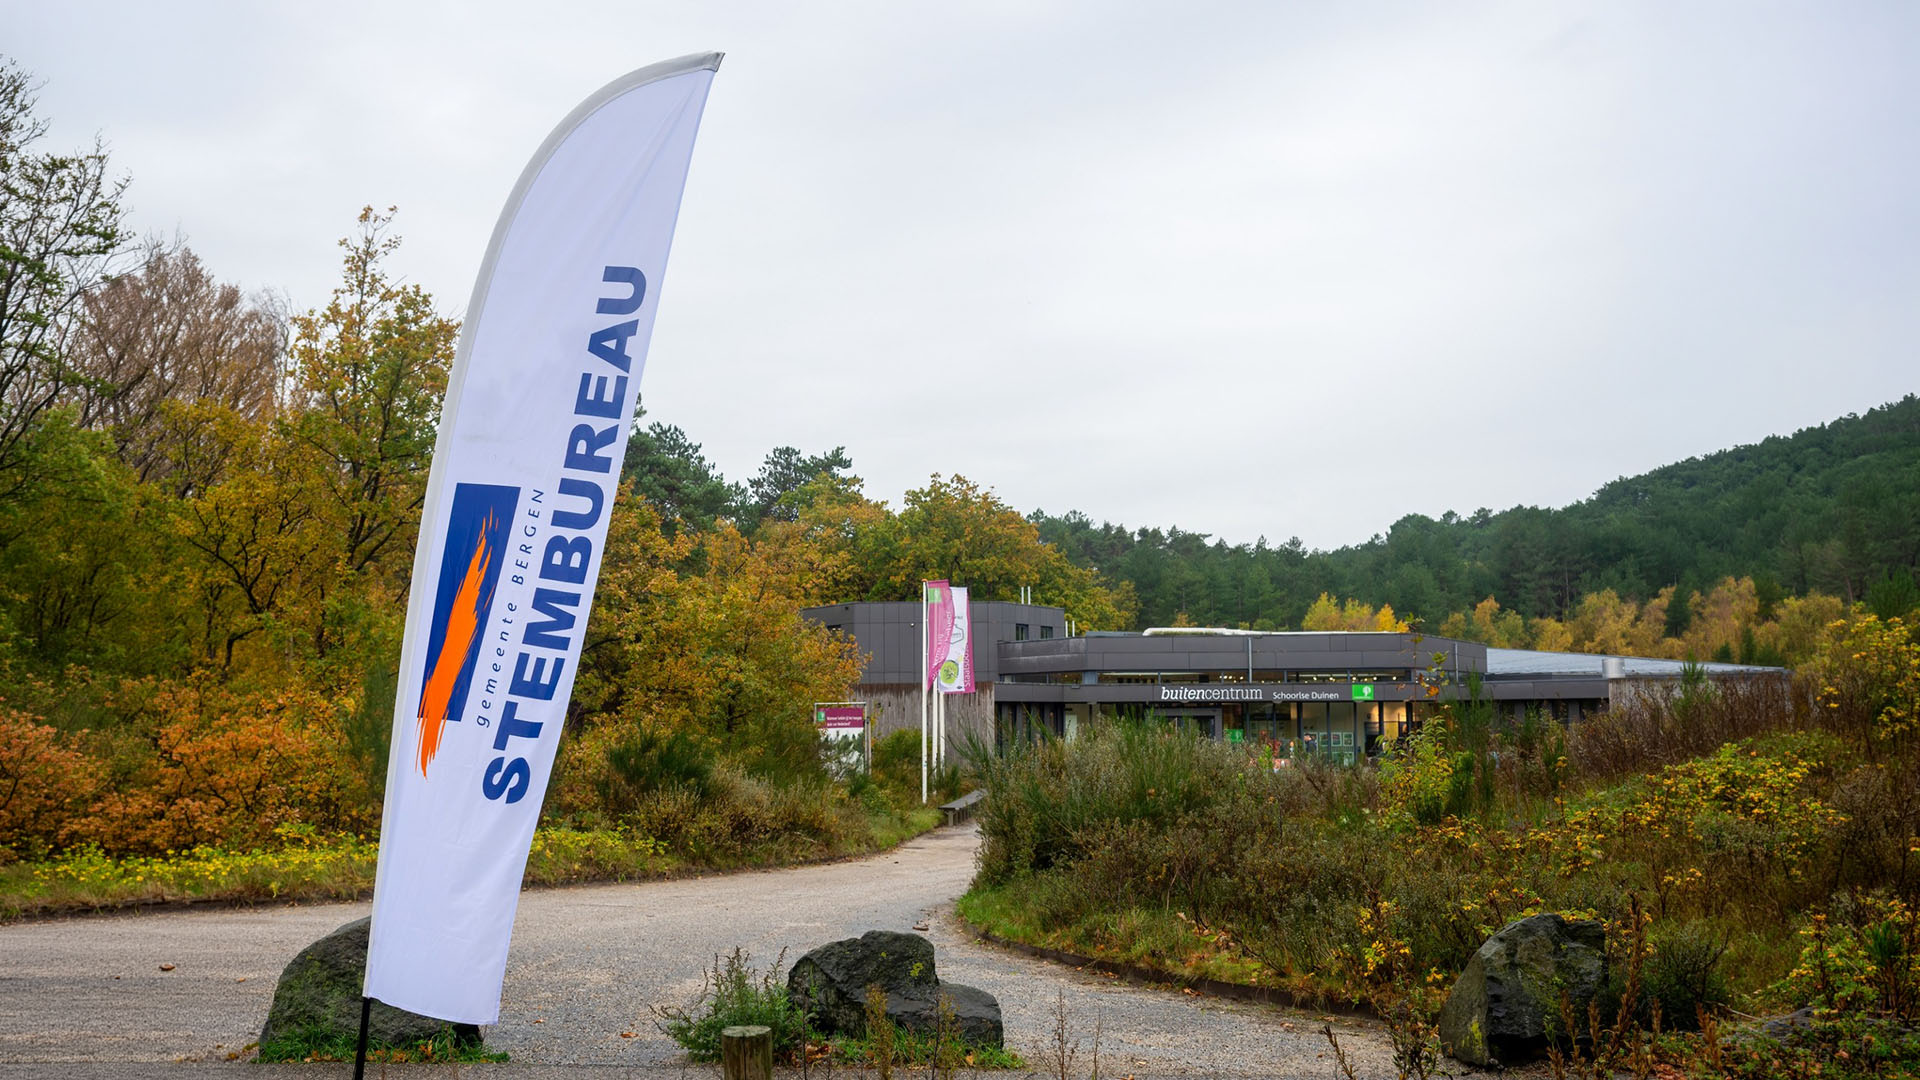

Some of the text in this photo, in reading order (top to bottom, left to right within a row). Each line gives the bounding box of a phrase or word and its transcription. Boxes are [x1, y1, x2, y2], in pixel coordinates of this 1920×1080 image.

[482, 265, 647, 804] STEMBUREAU
[476, 488, 545, 728] gemeente BERGEN
[1161, 686, 1263, 700] buitencentrum
[1272, 691, 1339, 700] Schoorlse Duinen
